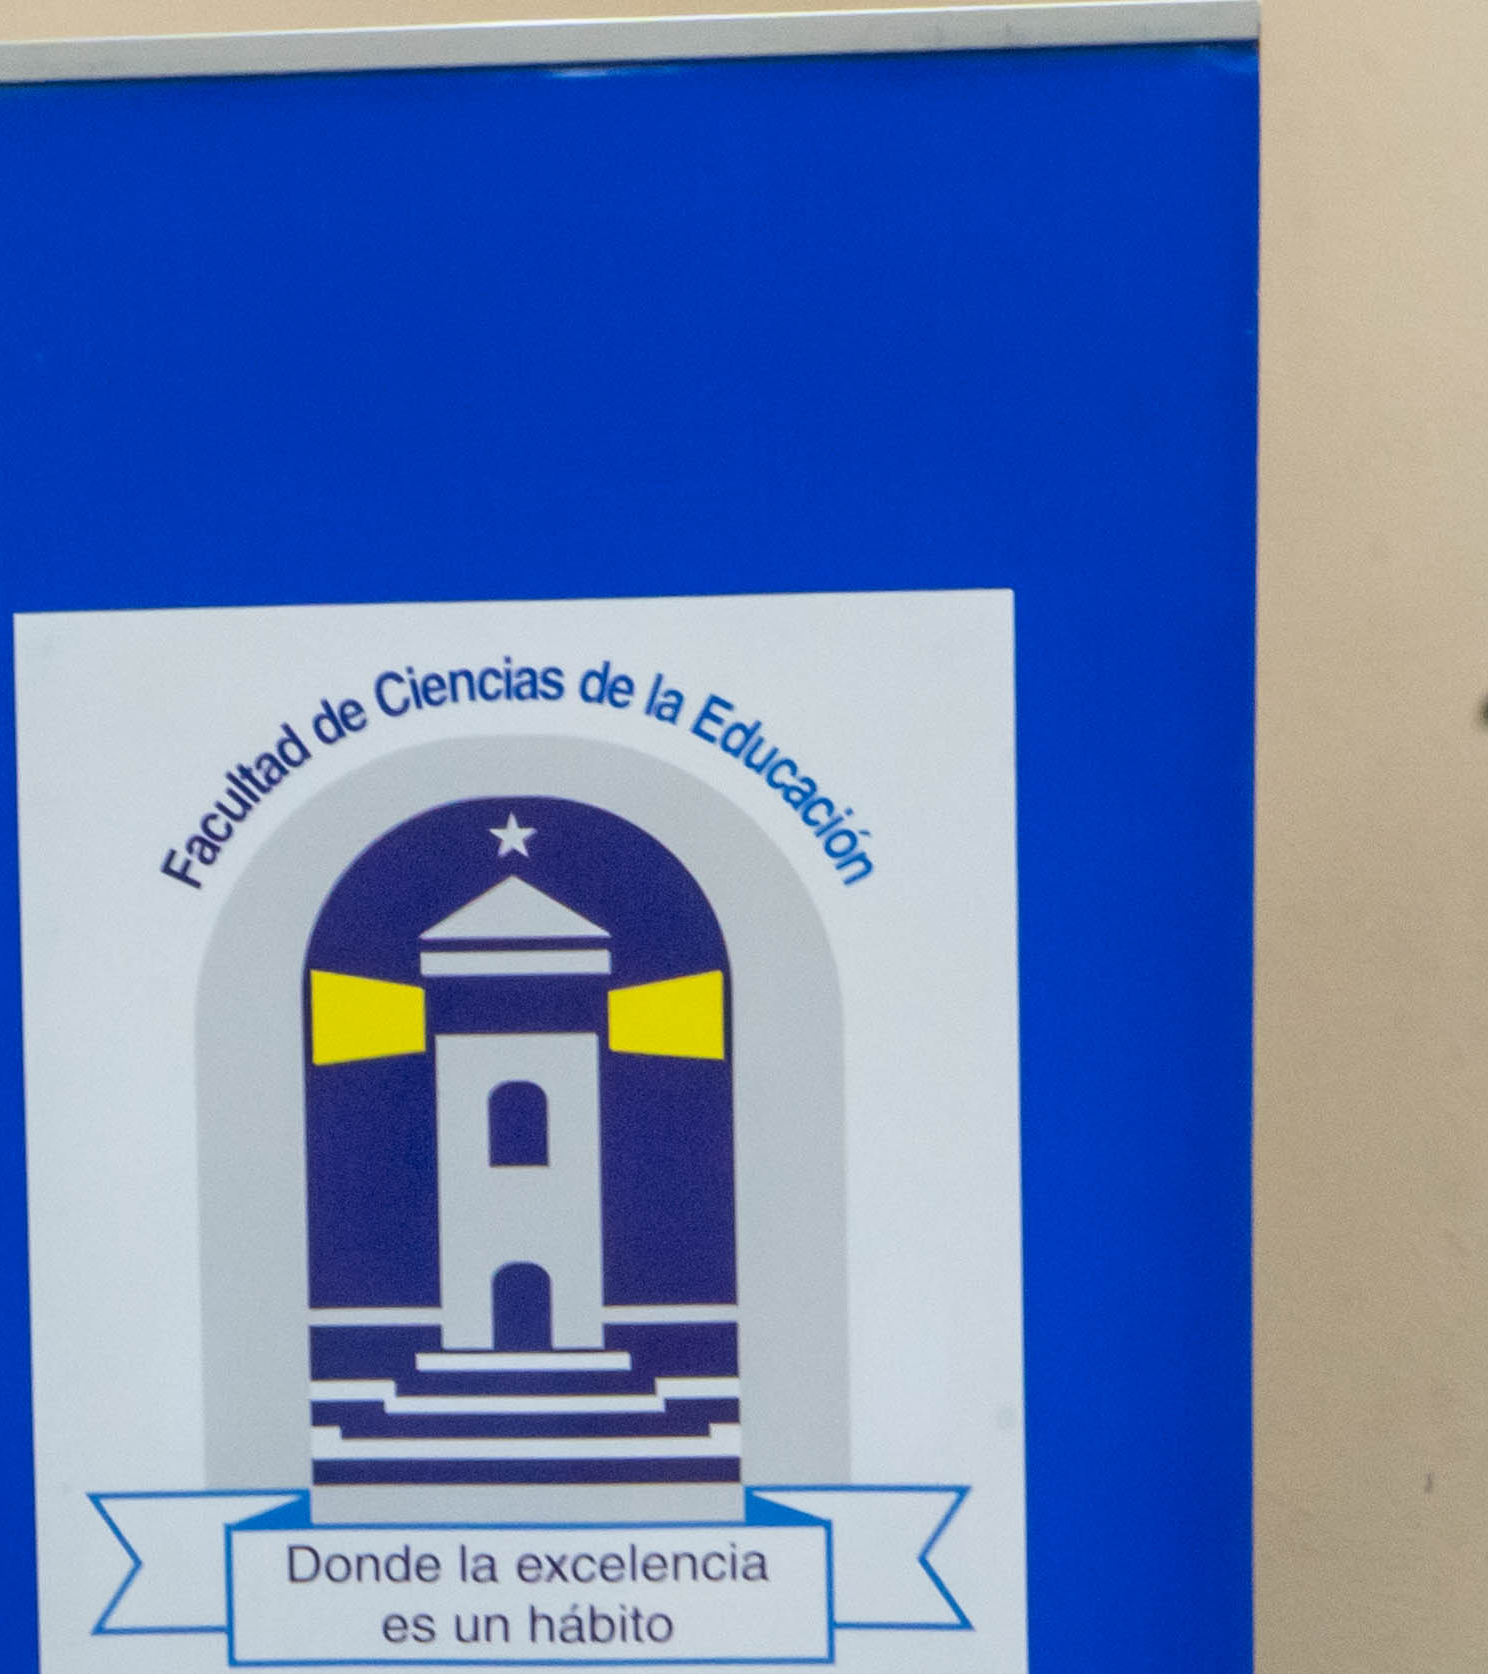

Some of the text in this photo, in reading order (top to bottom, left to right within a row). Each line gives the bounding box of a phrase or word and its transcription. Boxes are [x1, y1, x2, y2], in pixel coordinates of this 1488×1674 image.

[160, 657, 875, 890] Facultad de Ciencias de la Educación
[287, 1543, 769, 1584] Donde la excelencia
[382, 1604, 674, 1644] es un hábito
